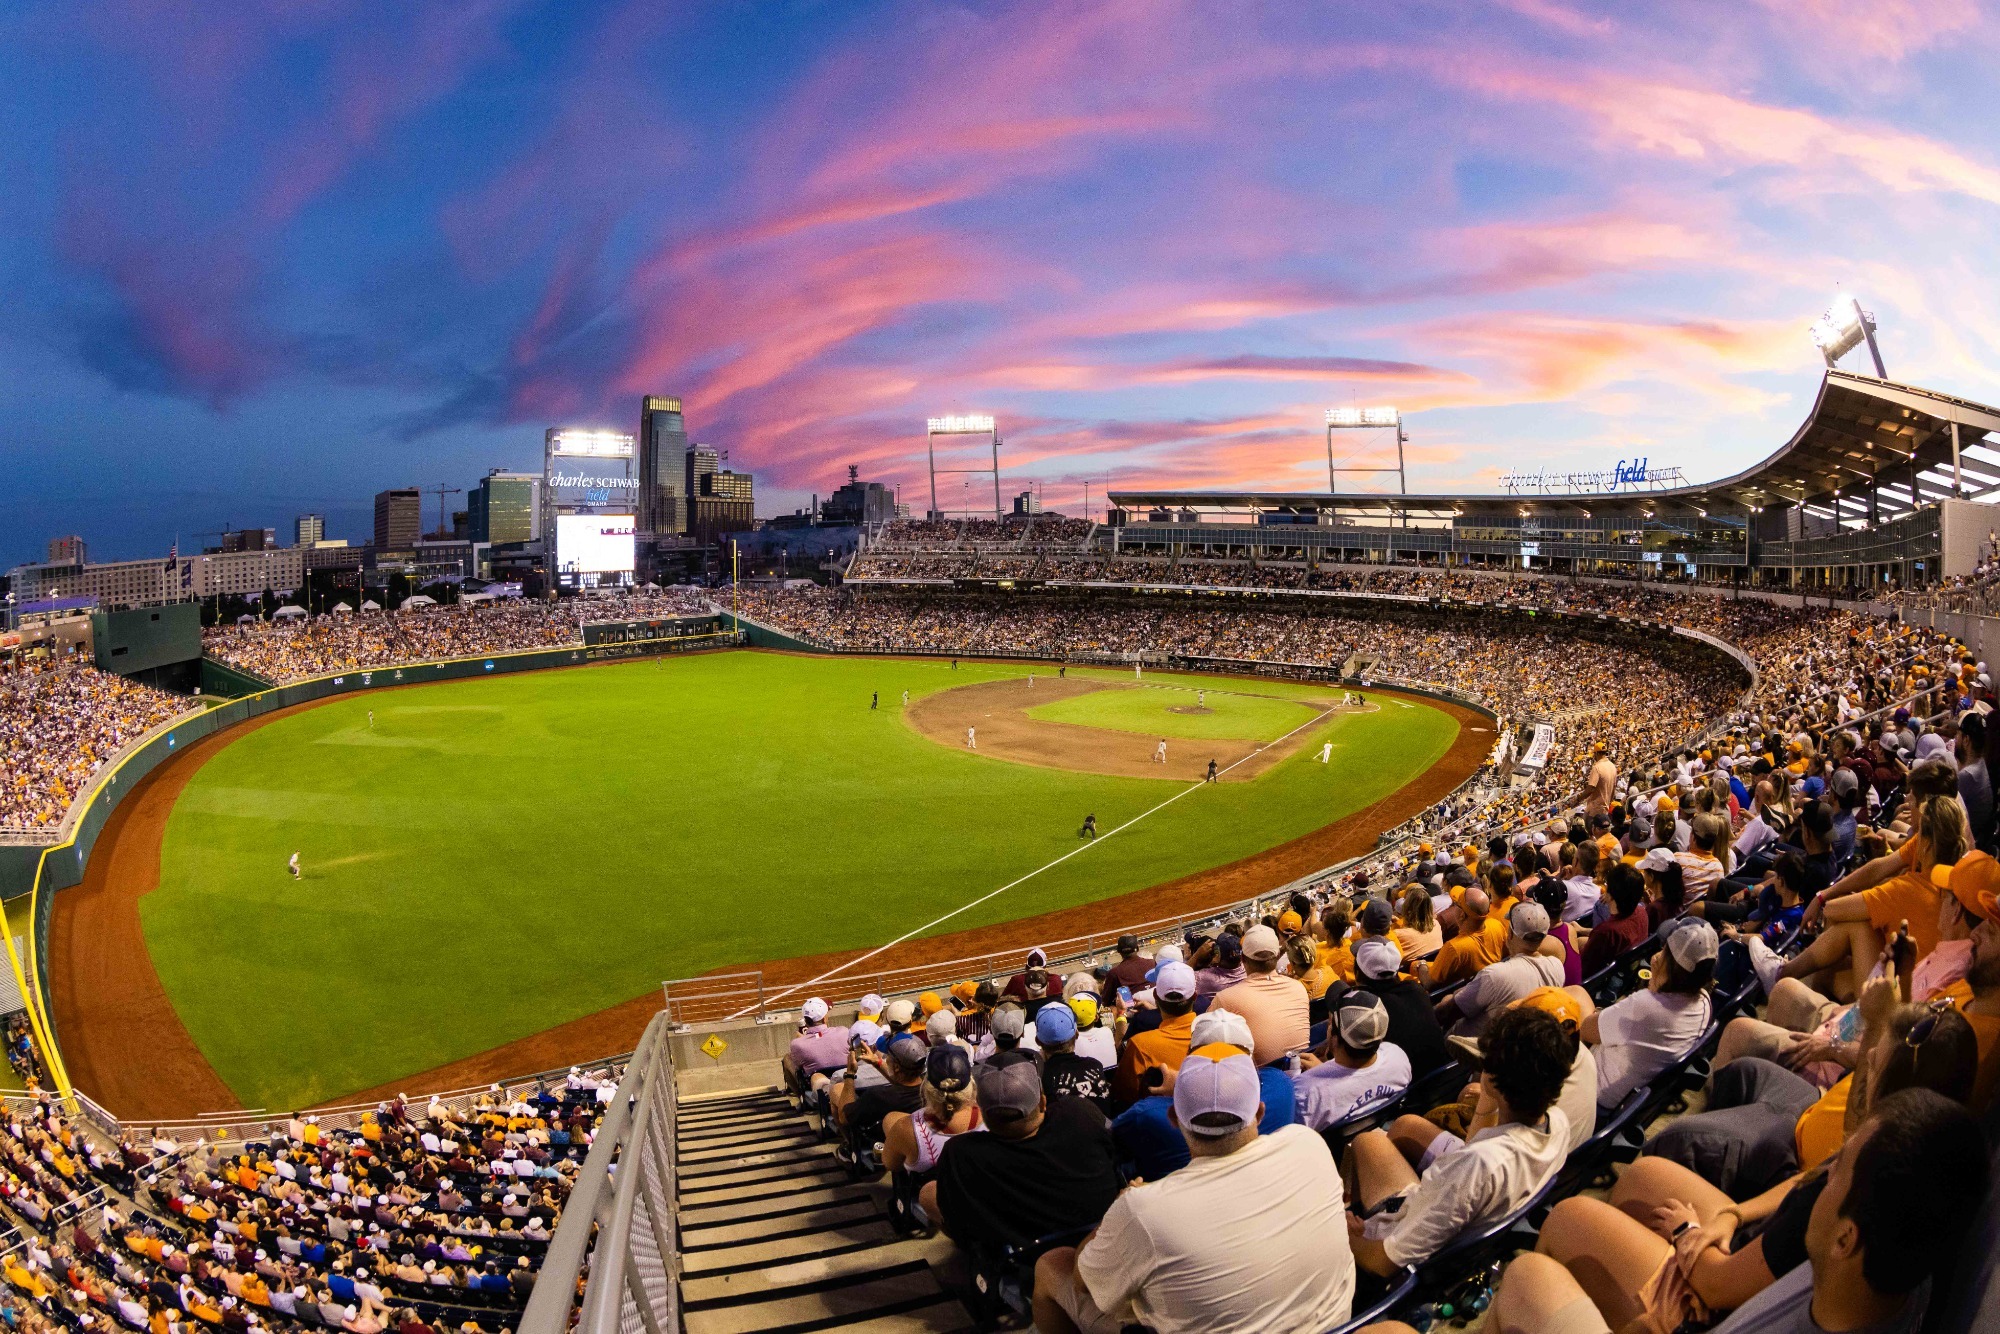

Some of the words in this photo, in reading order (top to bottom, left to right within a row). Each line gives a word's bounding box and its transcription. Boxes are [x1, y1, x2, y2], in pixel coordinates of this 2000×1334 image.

[549, 472, 594, 488] charles
[596, 477, 640, 489] SCHWAB
[1499, 466, 1556, 487] charles
[1560, 470, 1611, 485] SCHWAB
[1610, 457, 1647, 490] field
[1647, 467, 1680, 481] OMAHA
[585, 488, 610, 502] field
[1287, 921, 1295, 929] T
